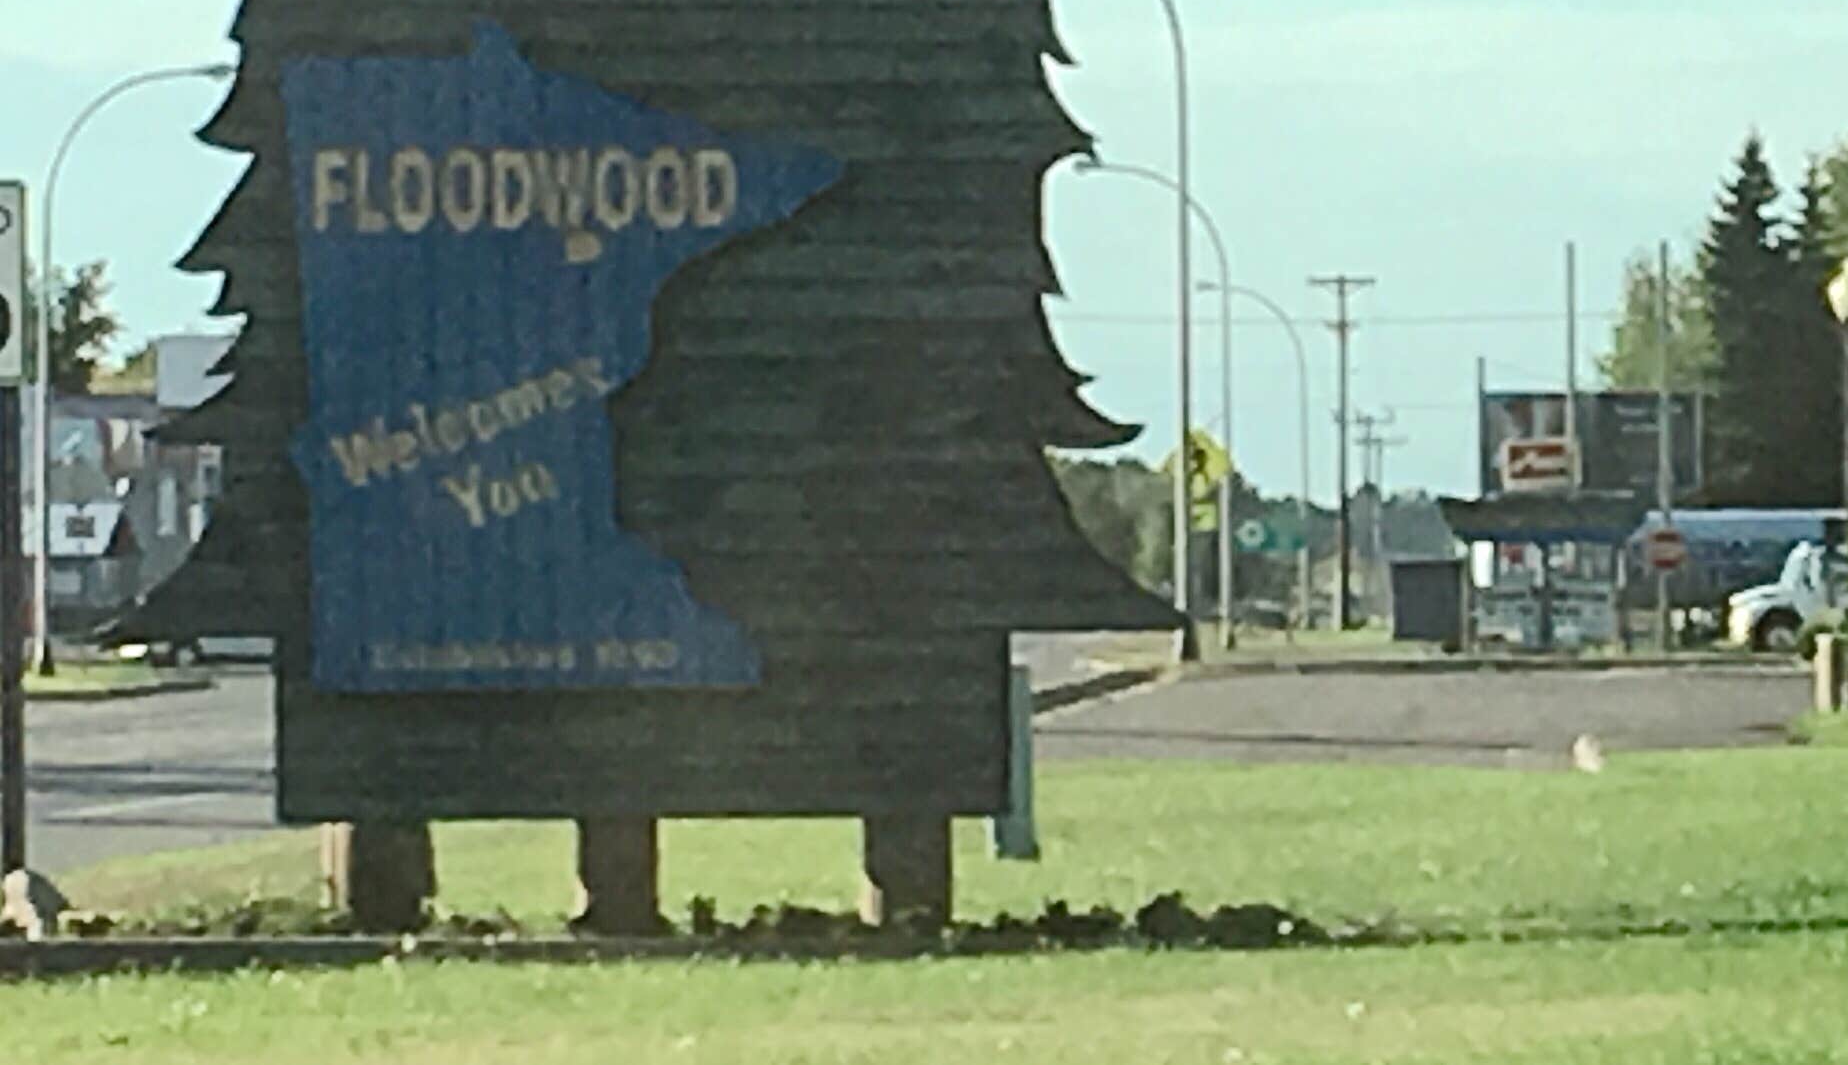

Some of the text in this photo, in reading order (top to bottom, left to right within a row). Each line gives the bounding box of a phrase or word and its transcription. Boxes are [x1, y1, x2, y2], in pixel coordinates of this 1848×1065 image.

[311, 146, 739, 234] FLOODWOOD
[330, 356, 610, 487] Welcomes
[440, 462, 560, 528] You
